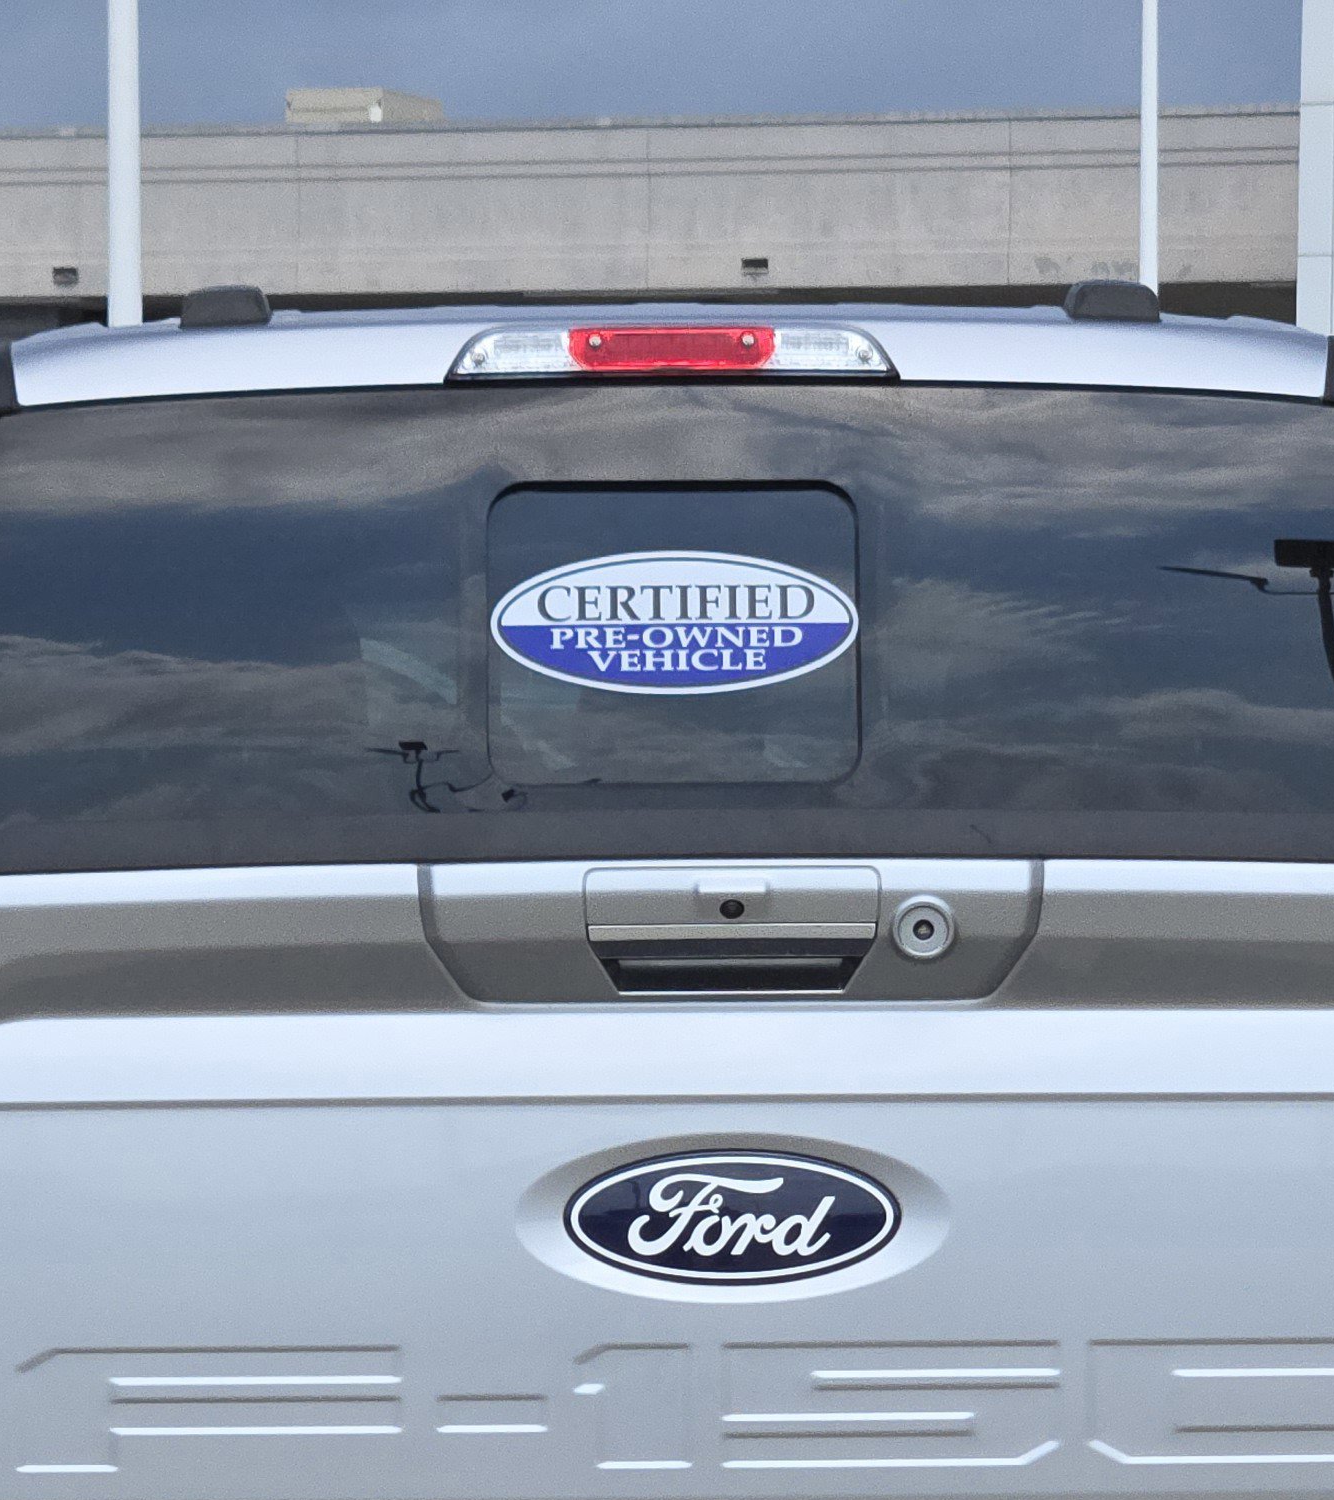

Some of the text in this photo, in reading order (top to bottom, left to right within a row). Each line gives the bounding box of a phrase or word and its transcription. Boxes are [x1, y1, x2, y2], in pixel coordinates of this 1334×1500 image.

[536, 583, 816, 623] CERTIFIED
[549, 625, 804, 650] PRE-OWNED
[586, 648, 767, 672] VEHICLE
[627, 1172, 836, 1257] Ford
